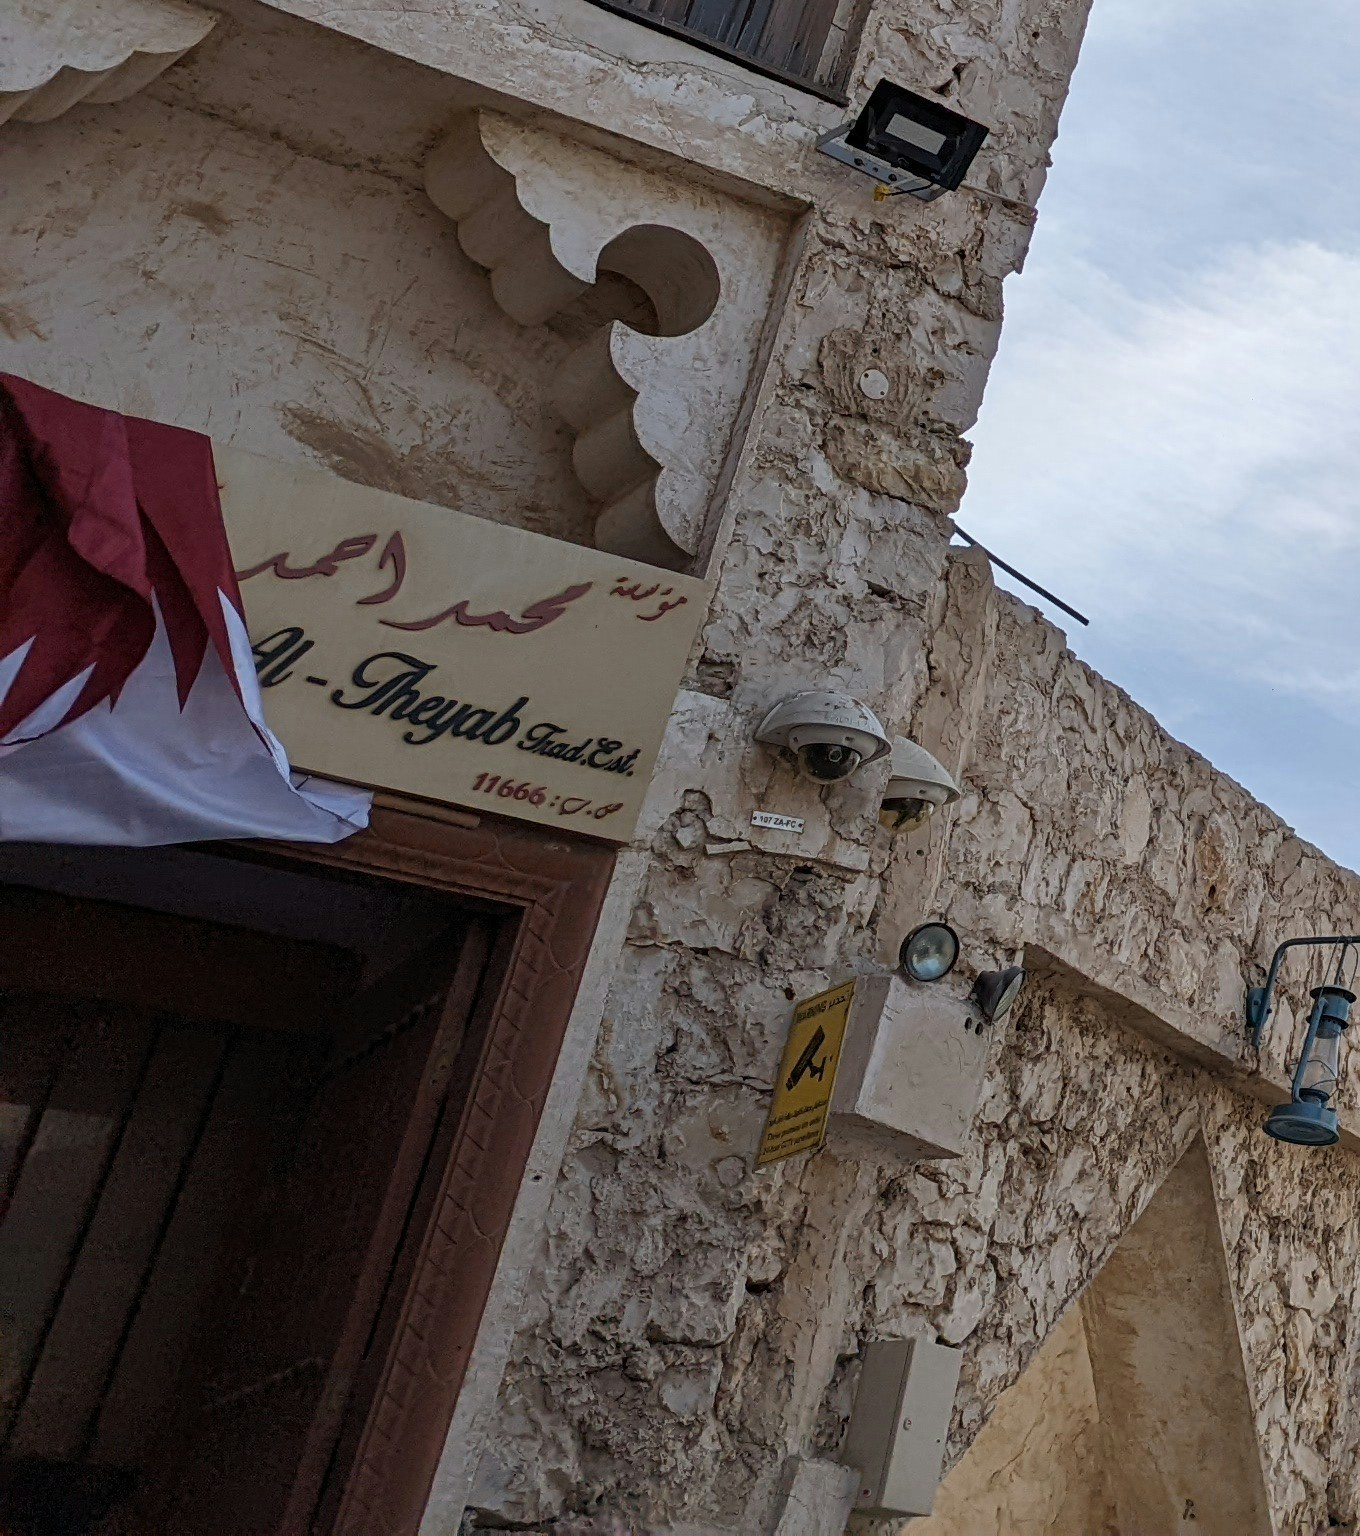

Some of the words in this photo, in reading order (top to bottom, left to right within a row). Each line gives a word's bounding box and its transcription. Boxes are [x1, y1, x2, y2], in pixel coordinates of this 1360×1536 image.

[379, 581, 594, 635] محمد
[472, 771, 548, 808] 11666
[759, 815, 773, 824] 107
